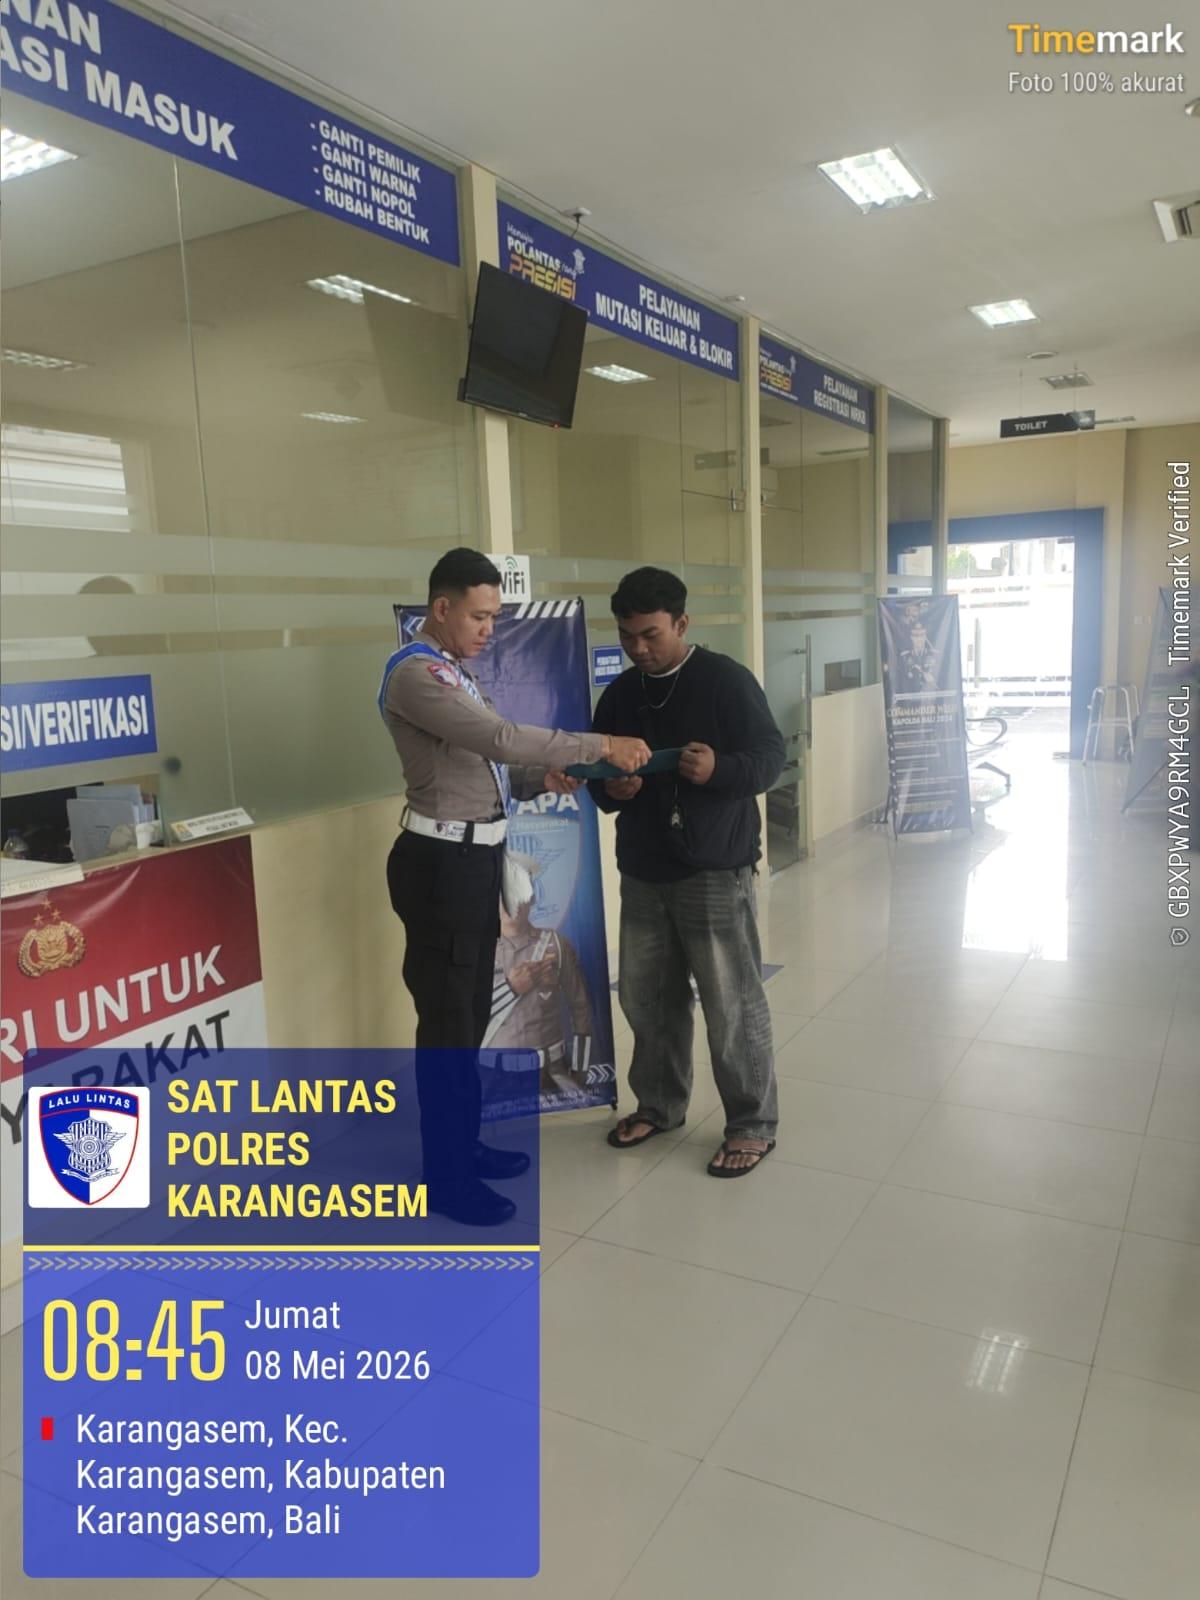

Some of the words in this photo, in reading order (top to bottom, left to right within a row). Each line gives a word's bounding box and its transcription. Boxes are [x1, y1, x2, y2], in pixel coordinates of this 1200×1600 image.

[84, 60, 239, 161] MASUK
[319, 119, 365, 157] GANTI
[367, 144, 422, 183] PEMILIK
[320, 142, 367, 179] GANTI
[369, 165, 418, 200] WARNA
[322, 165, 368, 200] GANTI
[371, 186, 416, 219] NOPOL
[324, 186, 374, 221] RUBAH
[376, 208, 430, 244] BENTUK
[507, 235, 561, 272] POLANTAS
[508, 252, 577, 302] PRESISI
[595, 291, 643, 333] MUTASI
[644, 314, 688, 355] KELUAR
[689, 337, 698, 356] &
[699, 337, 734, 371] BLOKIR
[638, 284, 701, 332] PELAYANAN
[813, 389, 850, 420] REGISTRASI
[823, 374, 859, 404] PELAYANAN
[1014, 420, 1049, 432] TOILET
[511, 791, 580, 816] APA
[55, 944, 226, 1044] UNTUK
